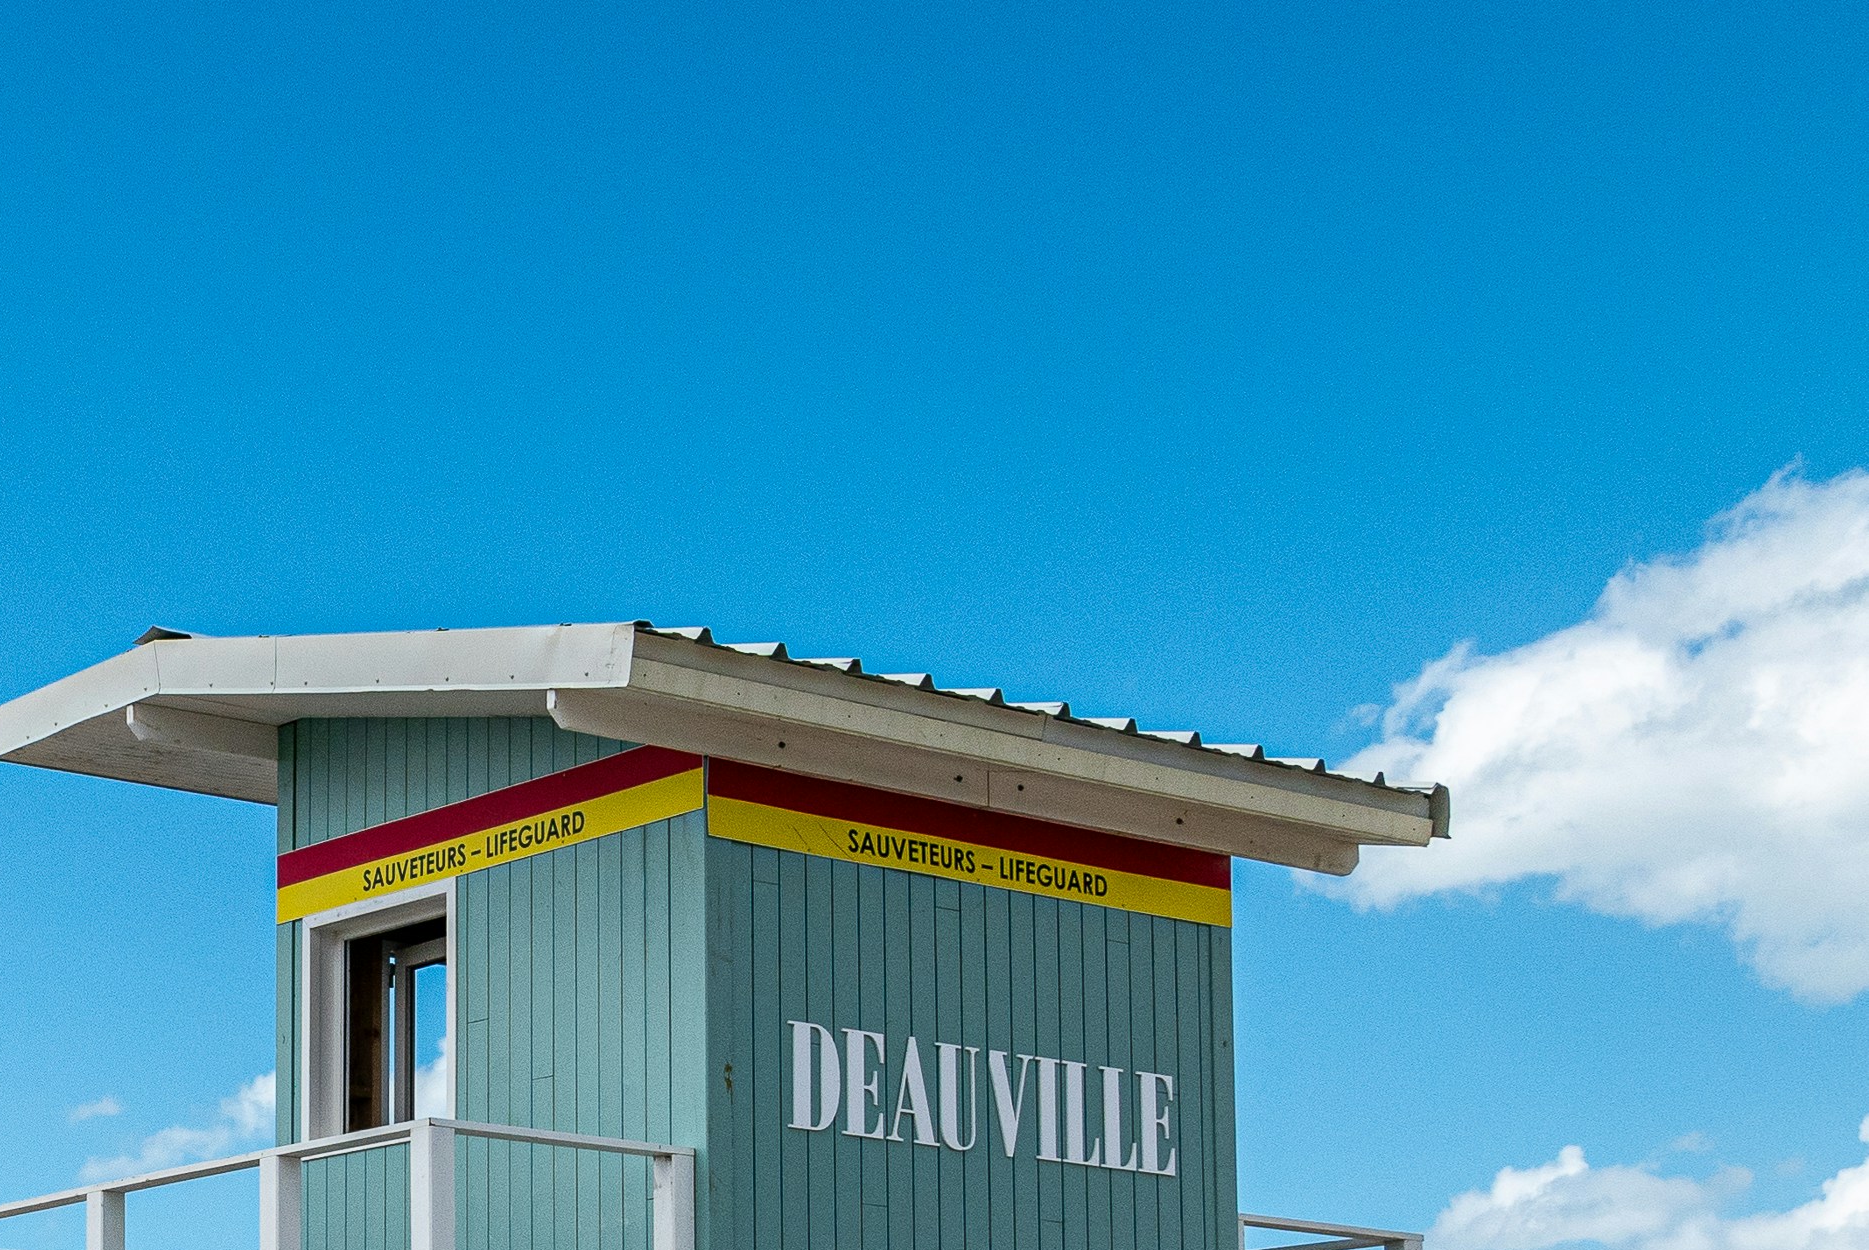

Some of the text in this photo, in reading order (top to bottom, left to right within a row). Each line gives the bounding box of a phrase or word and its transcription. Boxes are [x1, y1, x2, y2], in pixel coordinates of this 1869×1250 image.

[363, 843, 467, 892] SAUVETEURS
[486, 810, 585, 859] LIFEGUARD
[847, 829, 976, 874] SAUVETEURS
[999, 856, 1108, 897] LIFEGUARD
[786, 1020, 1177, 1177] DEAUVILLE
